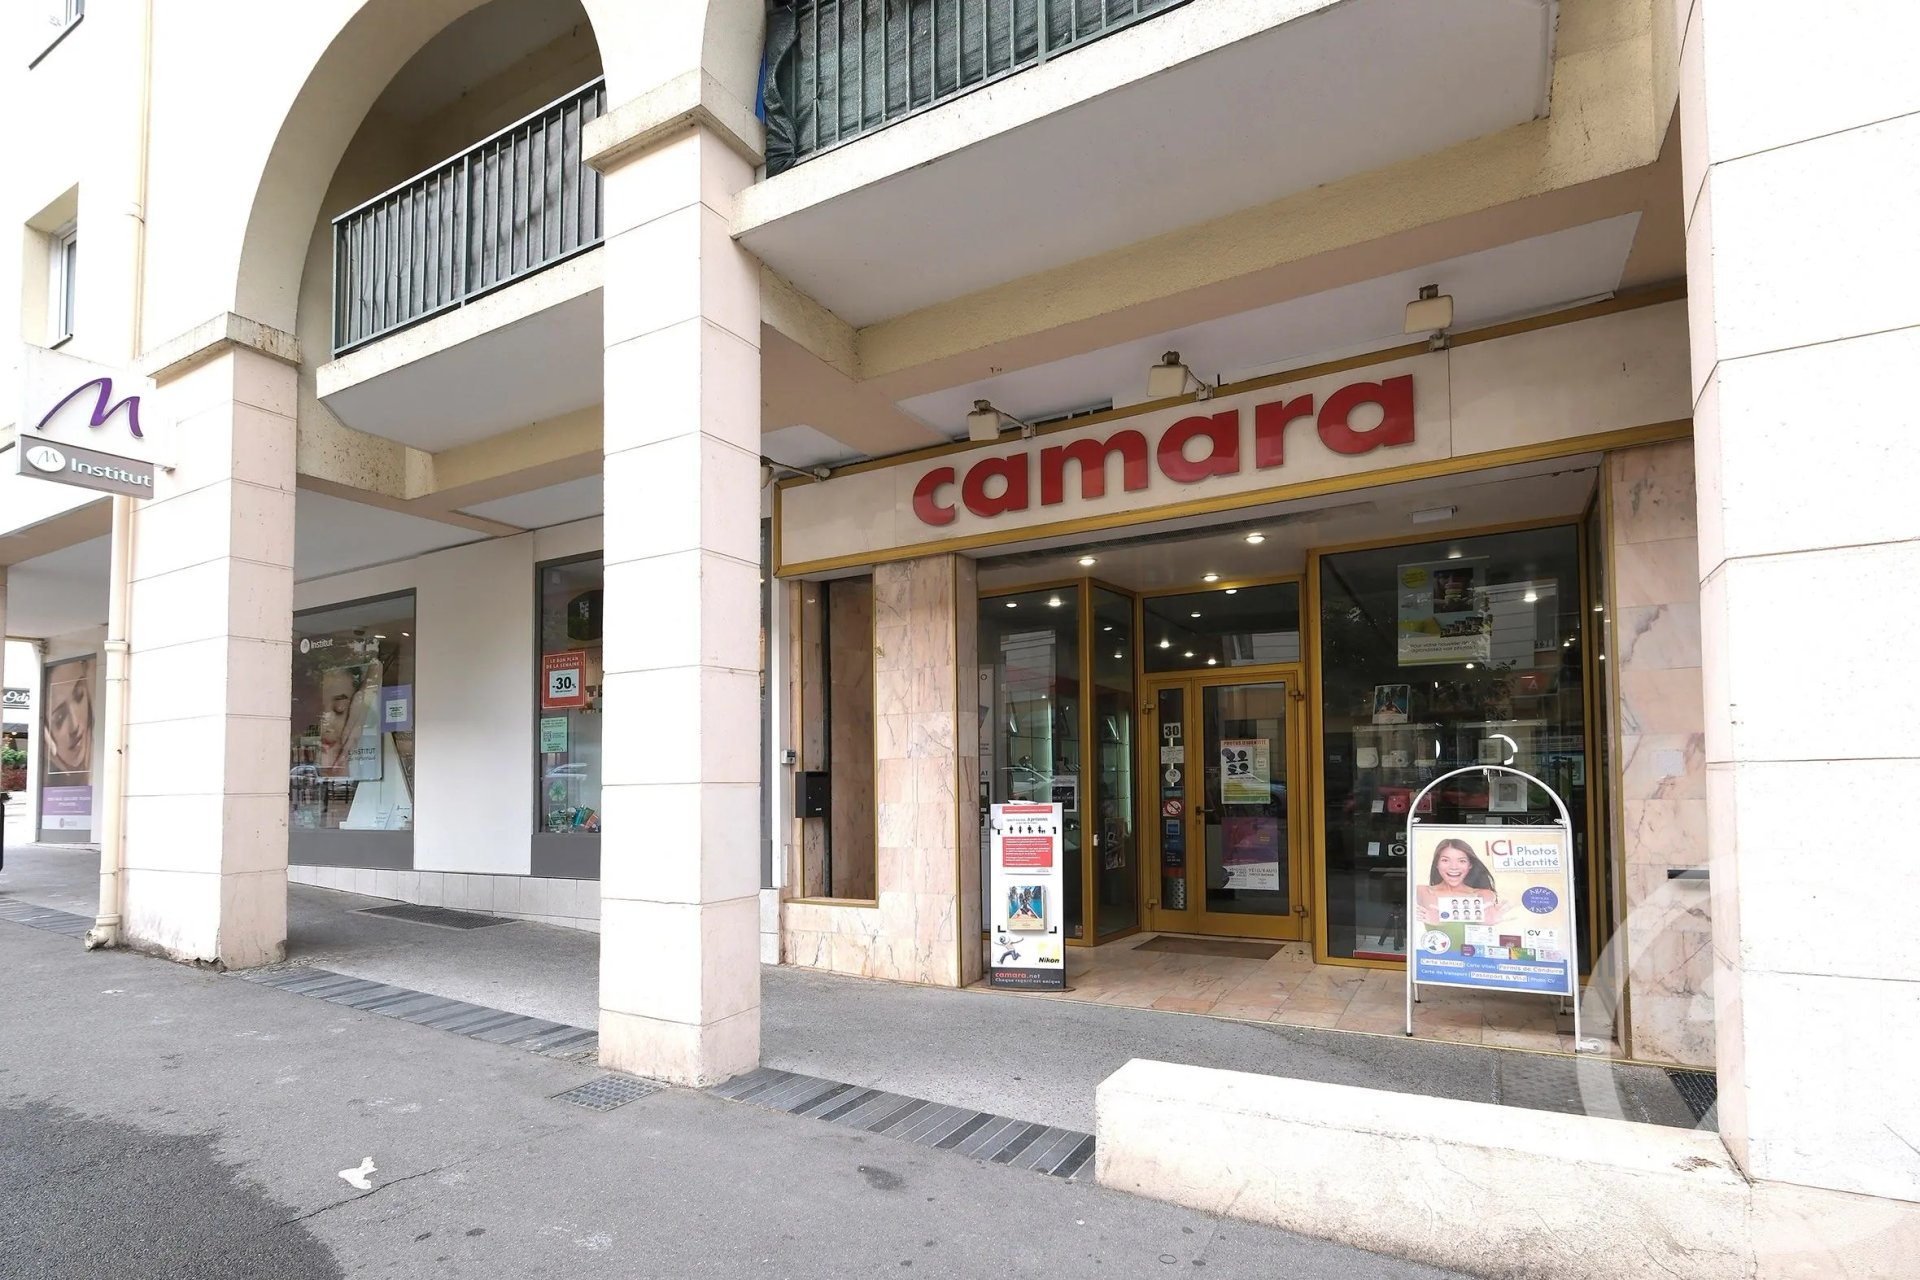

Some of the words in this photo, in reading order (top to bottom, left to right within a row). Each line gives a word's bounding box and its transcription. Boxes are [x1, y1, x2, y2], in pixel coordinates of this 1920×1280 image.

[913, 374, 1415, 525] camara
[71, 458, 152, 487] Institut
[311, 638, 334, 649] Institut
[1165, 725, 1180, 737] 30
[1485, 839, 1513, 857] ICI
[1516, 846, 1557, 856] Photos
[1502, 856, 1559, 867] d'identité
[1038, 956, 1060, 964] Nikon
